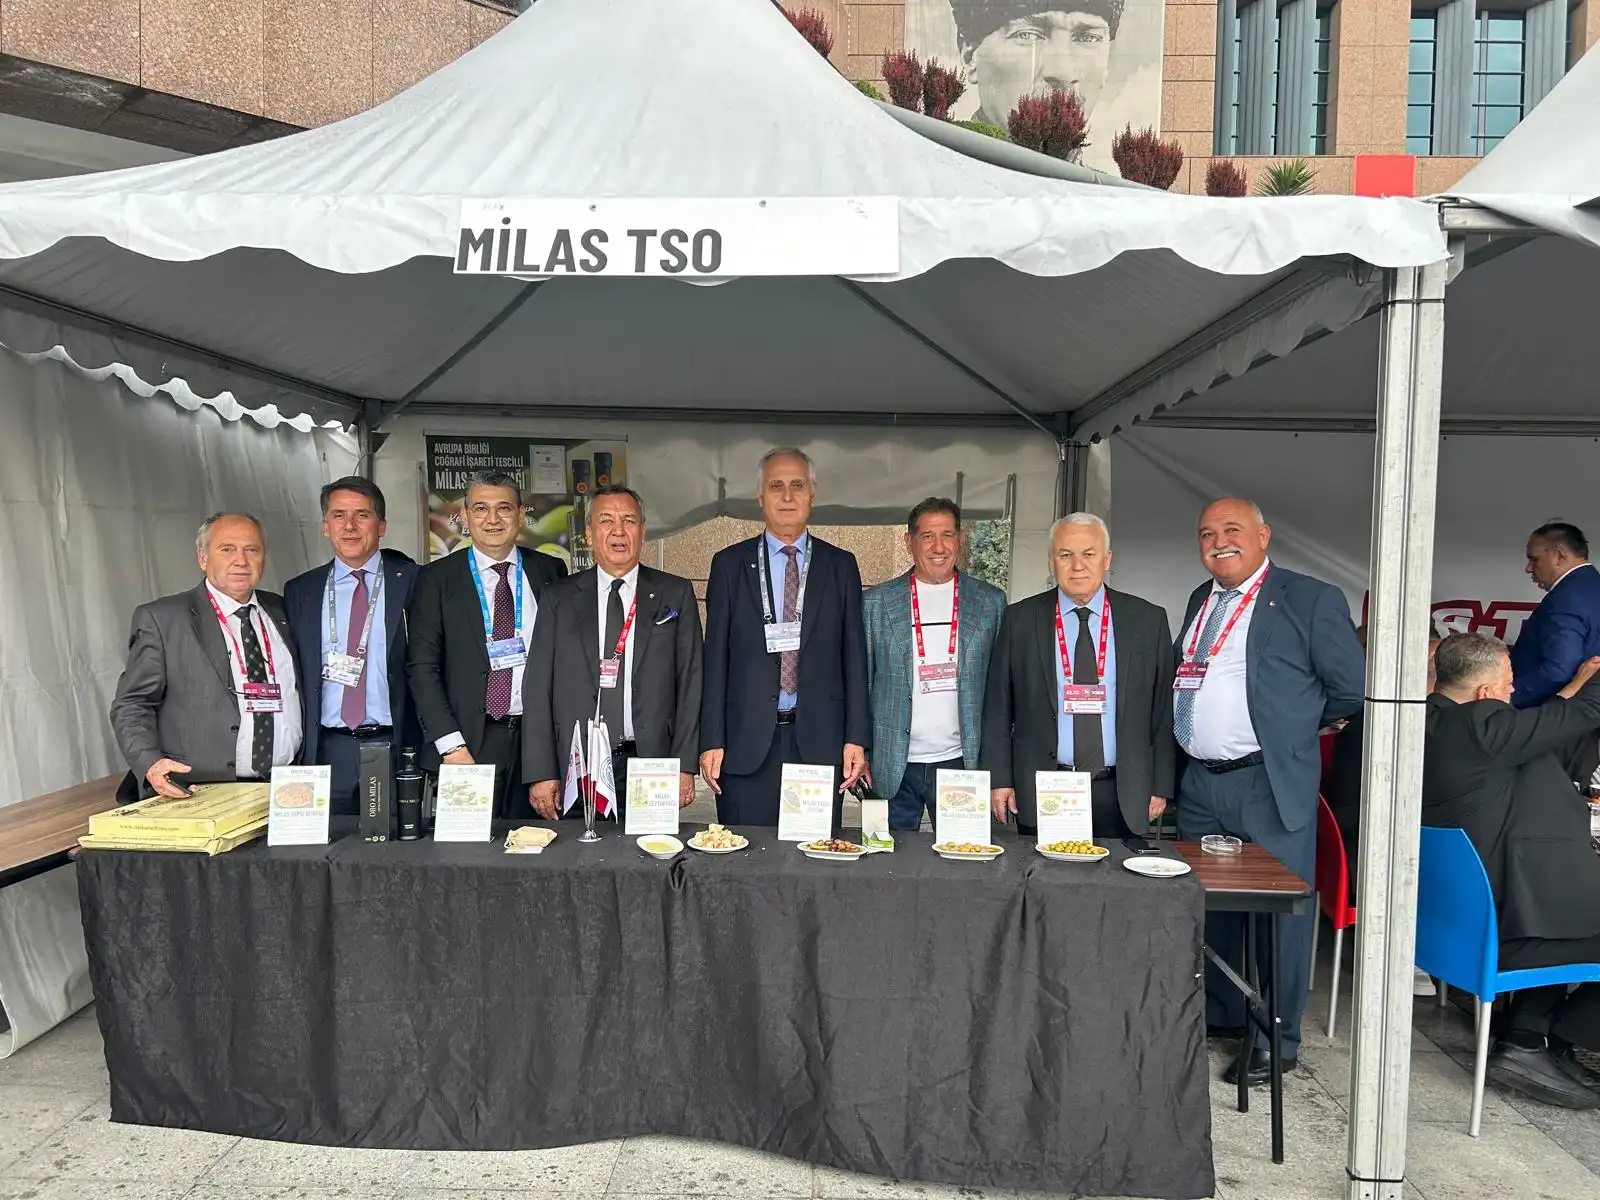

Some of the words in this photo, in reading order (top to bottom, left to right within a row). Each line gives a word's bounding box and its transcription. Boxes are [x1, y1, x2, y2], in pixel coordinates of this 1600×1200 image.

[457, 217, 609, 273] MİLAS
[627, 228, 722, 273] TSO
[434, 443, 463, 454] AVRUPA
[464, 442, 490, 454] BİRLİĞİ
[434, 455, 466, 467] COĞRAFİ
[466, 455, 494, 468] İŞARETİ
[495, 455, 524, 468] TESCİLLİ
[435, 468, 467, 490] MİLAS
[369, 802, 377, 818] ORO
